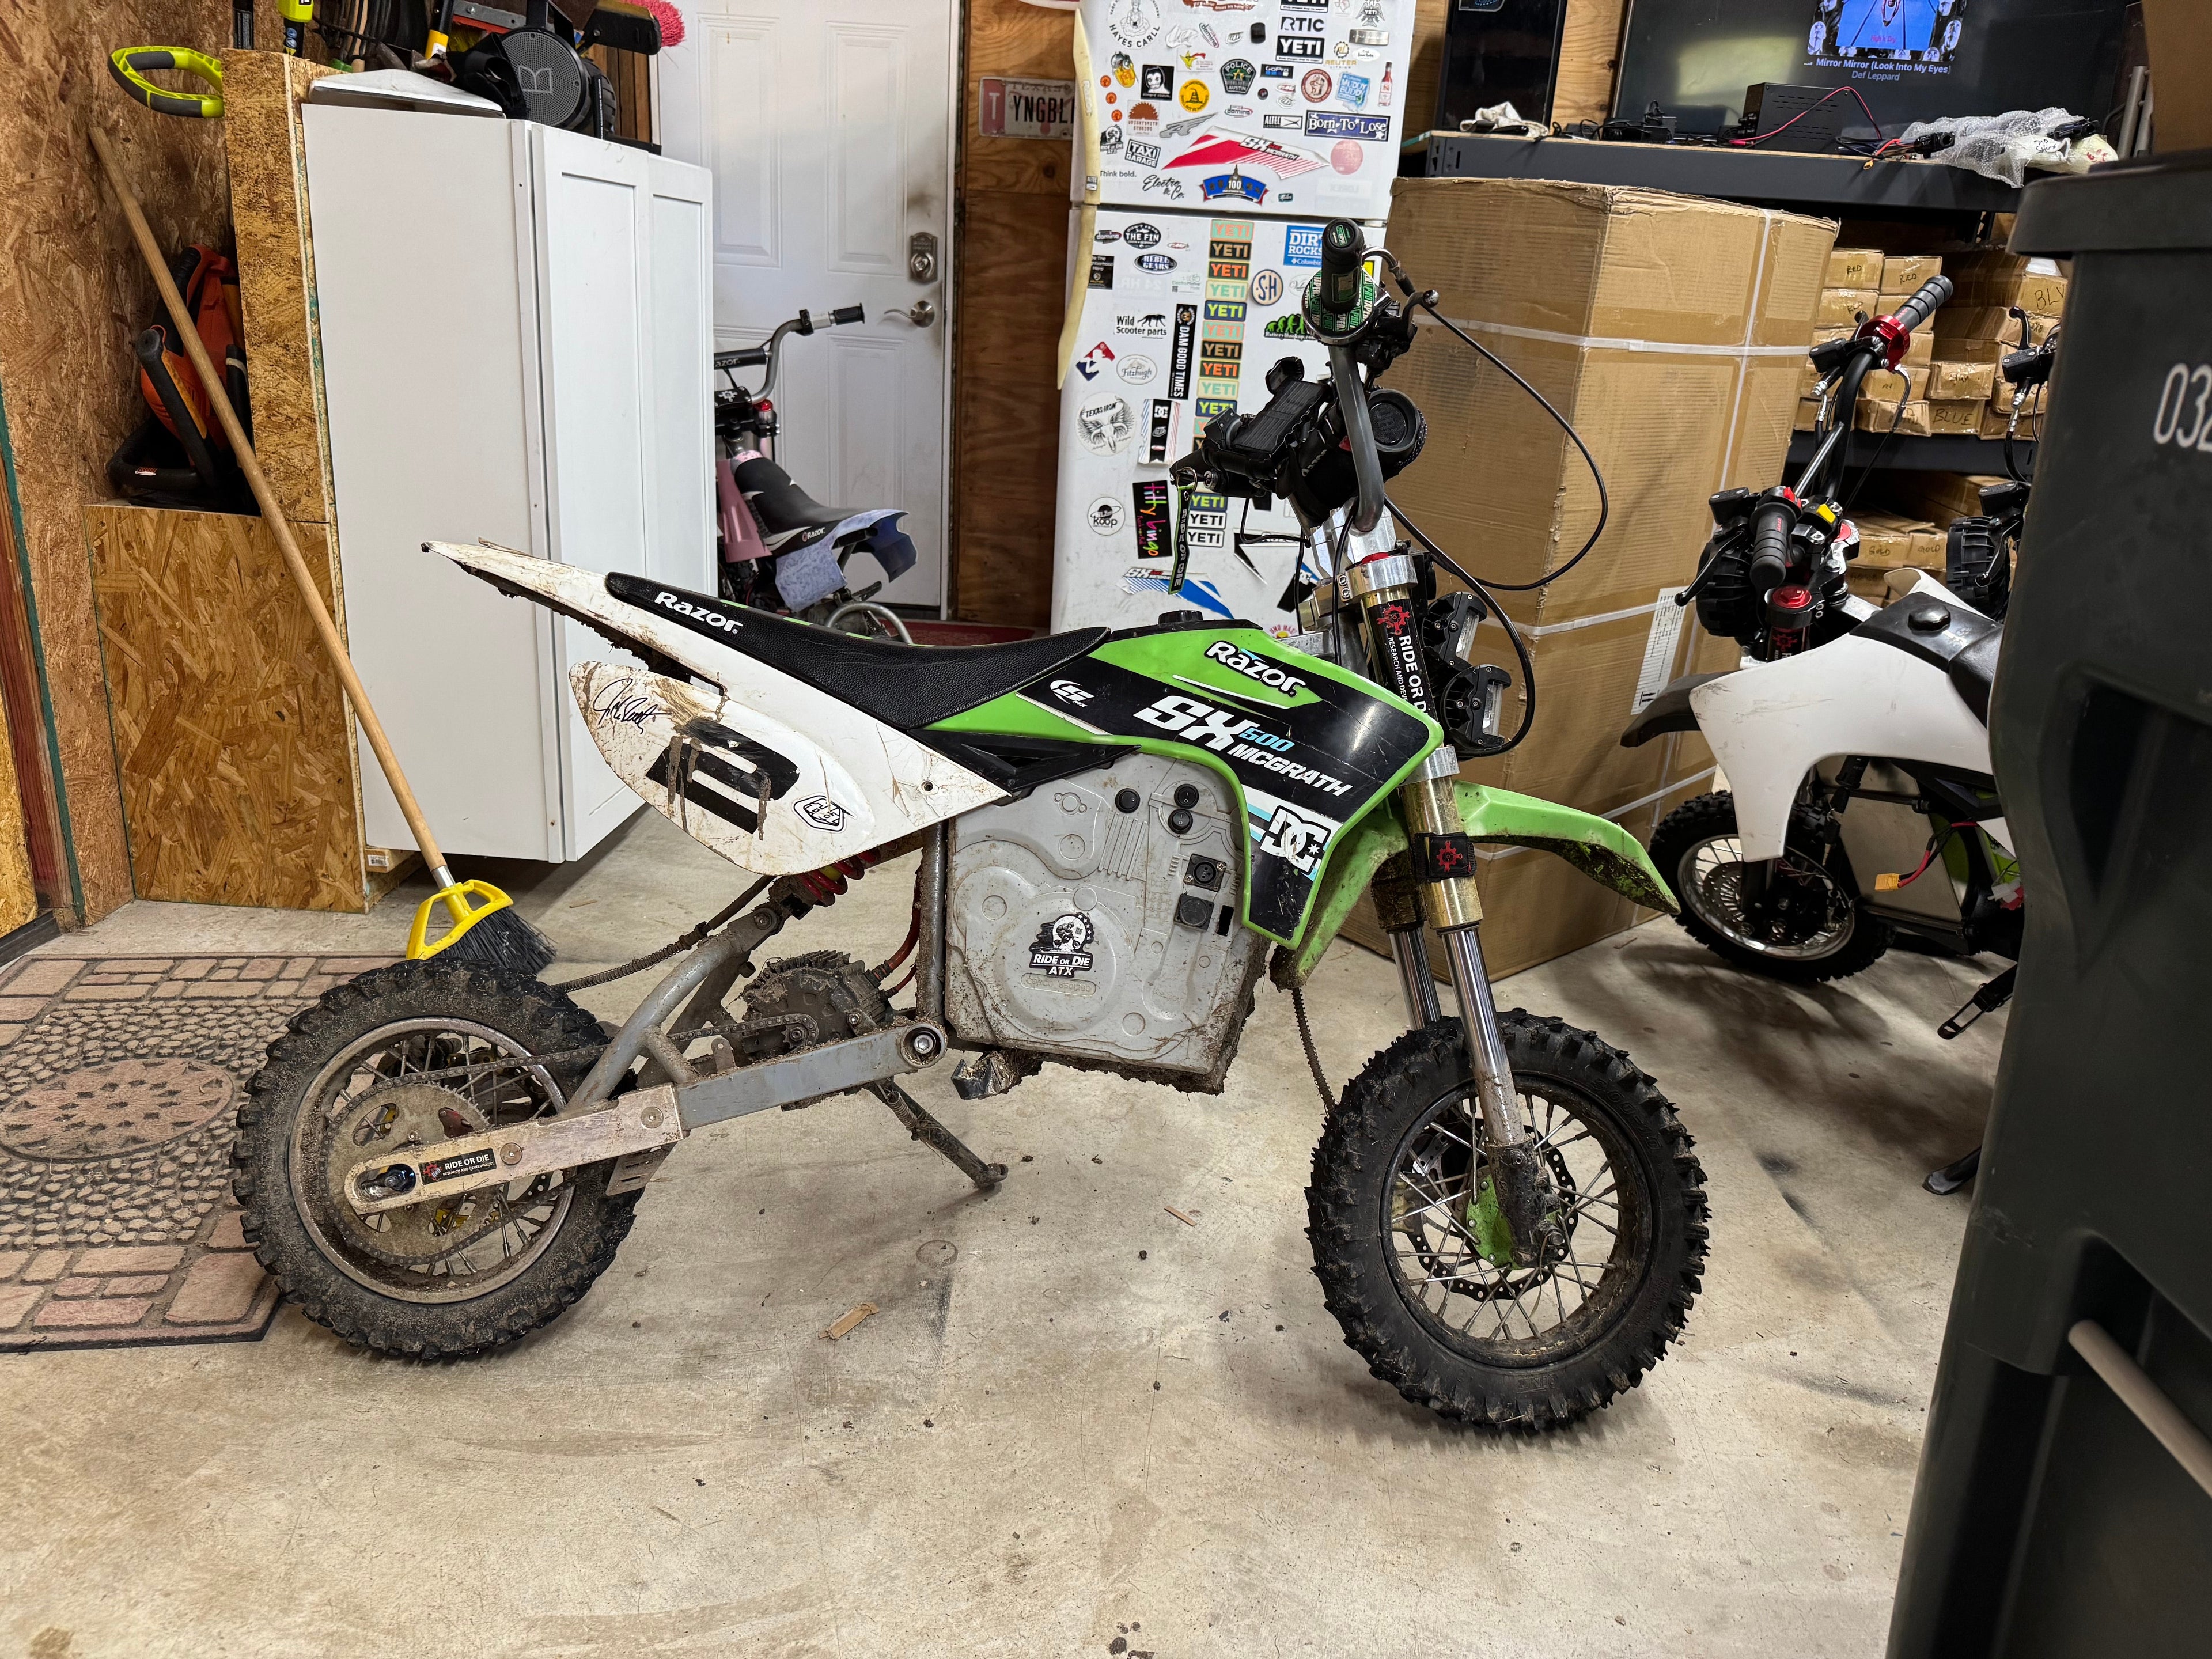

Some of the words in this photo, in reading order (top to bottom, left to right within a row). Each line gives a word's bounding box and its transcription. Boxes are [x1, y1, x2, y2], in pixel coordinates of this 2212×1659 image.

[1281, 16, 1325, 32] RTIC
[1109, 24, 1133, 48] HAYES
[1137, 25, 1160, 47] CARLL
[1280, 38, 1321, 56] YETI
[1224, 62, 1254, 75] POLICE
[1816, 58, 1842, 67] Mirror
[1844, 59, 1869, 69] Mirror
[1871, 60, 1895, 71] (Look
[1895, 62, 1912, 71] Into
[1914, 63, 1927, 74] My
[1851, 70, 1866, 79] Def
[1868, 71, 1900, 82] Leppard
[1340, 79, 1368, 90] MUDDY
[1339, 88, 1366, 97] BUDDY
[1264, 116, 1281, 125] ALTEC
[1309, 118, 1335, 130] Born
[1340, 118, 1355, 131] To
[1359, 121, 1387, 134] Lose
[1132, 143, 1157, 158] TAXI
[1240, 137, 1270, 152] SX
[1126, 154, 1157, 168] GARAGE
[1142, 175, 1181, 191] Electro
[1228, 180, 1242, 190] 100
[1171, 185, 1184, 200] Co.
[1125, 233, 1142, 241] THE
[1144, 233, 1160, 241] FIN
[1214, 223, 1250, 237] YETI
[1212, 243, 1249, 258] YETI
[1143, 255, 1169, 263] REBEL
[1143, 263, 1170, 271] GEARS
[1211, 263, 1247, 278] YETI
[1846, 264, 1862, 275] RED
[1899, 272, 1918, 285] RED
[1210, 283, 1245, 298] YETI
[1207, 304, 1244, 319] YETI
[1116, 315, 1135, 326] Wild
[1116, 326, 1146, 335] Scooter
[1147, 328, 1167, 336] parts
[1179, 325, 1190, 346] DAM
[1206, 323, 1241, 338] YETI
[1204, 343, 1240, 358] YETI
[1176, 347, 1188, 370] GOOD
[1121, 365, 1152, 380] Fitzhugh
[1202, 362, 1238, 377] YETI
[1173, 370, 1187, 397] TIMES
[1201, 381, 1237, 396] YETI
[1086, 406, 1104, 418] TEXAS
[1103, 402, 1118, 413] IRON
[1154, 405, 1169, 419] DC
[1933, 408, 1974, 426] BLUE
[1191, 495, 1225, 509] YETI
[1093, 518, 1118, 528] koop
[1179, 508, 1188, 543] RIDE
[1190, 514, 1223, 527] YETI
[1142, 520, 1167, 557] bingo
[1188, 531, 1220, 544] YETI
[1179, 543, 1188, 562] OR
[1124, 567, 1152, 578] SX
[1174, 562, 1185, 588] DIE
[1269, 624, 1281, 635] UNO
[1387, 637, 1400, 669] RESEARCH
[1395, 669, 1404, 685] AND
[1399, 634, 1415, 673] RIDE
[1408, 673, 1423, 699] OR
[1132, 695, 1252, 752] SX
[1237, 721, 1296, 752] 500
[1226, 744, 1354, 797] MCGRATH
[1260, 807, 1332, 872] DC
[1033, 953, 1058, 965] RIDE
[1071, 956, 1090, 967] DIE
[1048, 966, 1074, 976] ATX
[444, 1160, 463, 1171] RIDE
[464, 1157, 476, 1166] OR
[476, 1154, 490, 1164] DIE
